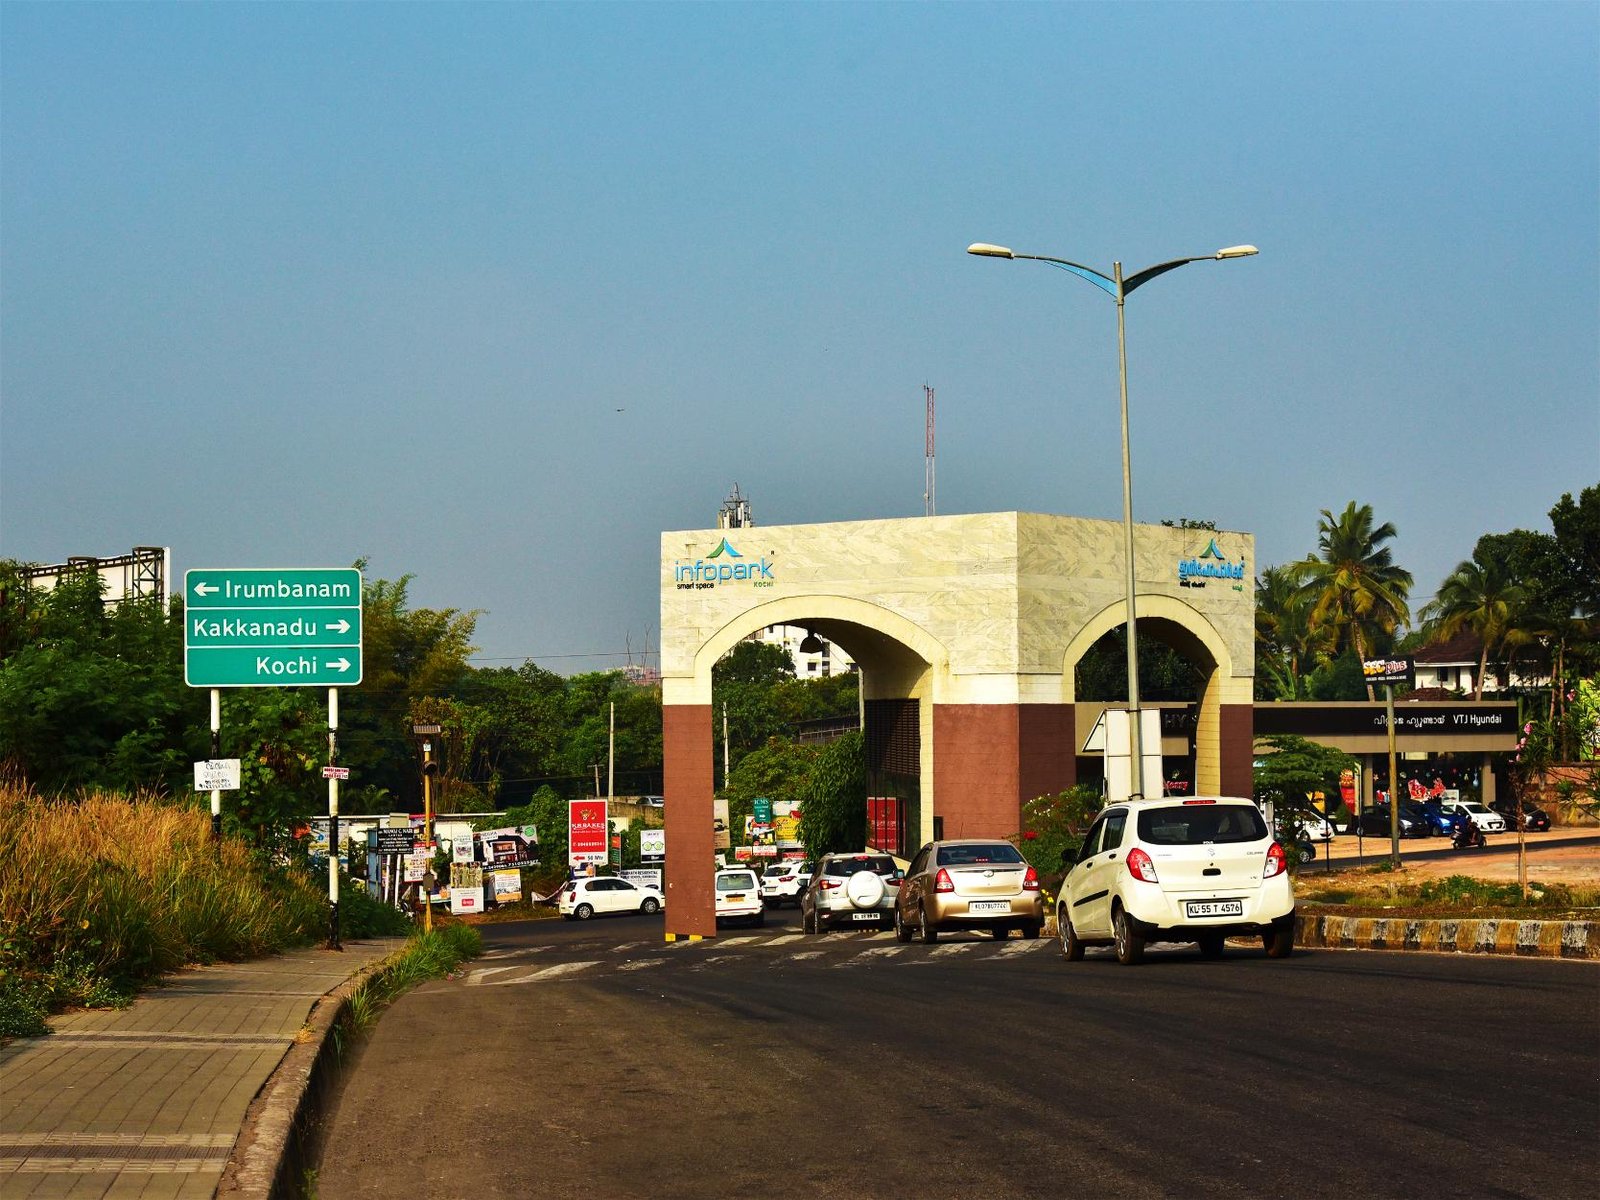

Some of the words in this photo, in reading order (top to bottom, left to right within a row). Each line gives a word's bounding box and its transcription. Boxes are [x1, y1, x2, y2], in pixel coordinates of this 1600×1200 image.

[675, 557, 775, 585] infopark
[225, 580, 350, 598] Irumbanam
[695, 582, 715, 591] space
[194, 618, 317, 637] Kakkanadu
[256, 656, 317, 675] Kochi
[1453, 714, 1468, 724] VTJ
[1470, 714, 1502, 726] Hyundai
[1189, 905, 1198, 914] KL
[1201, 905, 1211, 913] 55
[1213, 904, 1218, 913] T
[1221, 904, 1240, 912] 4576
